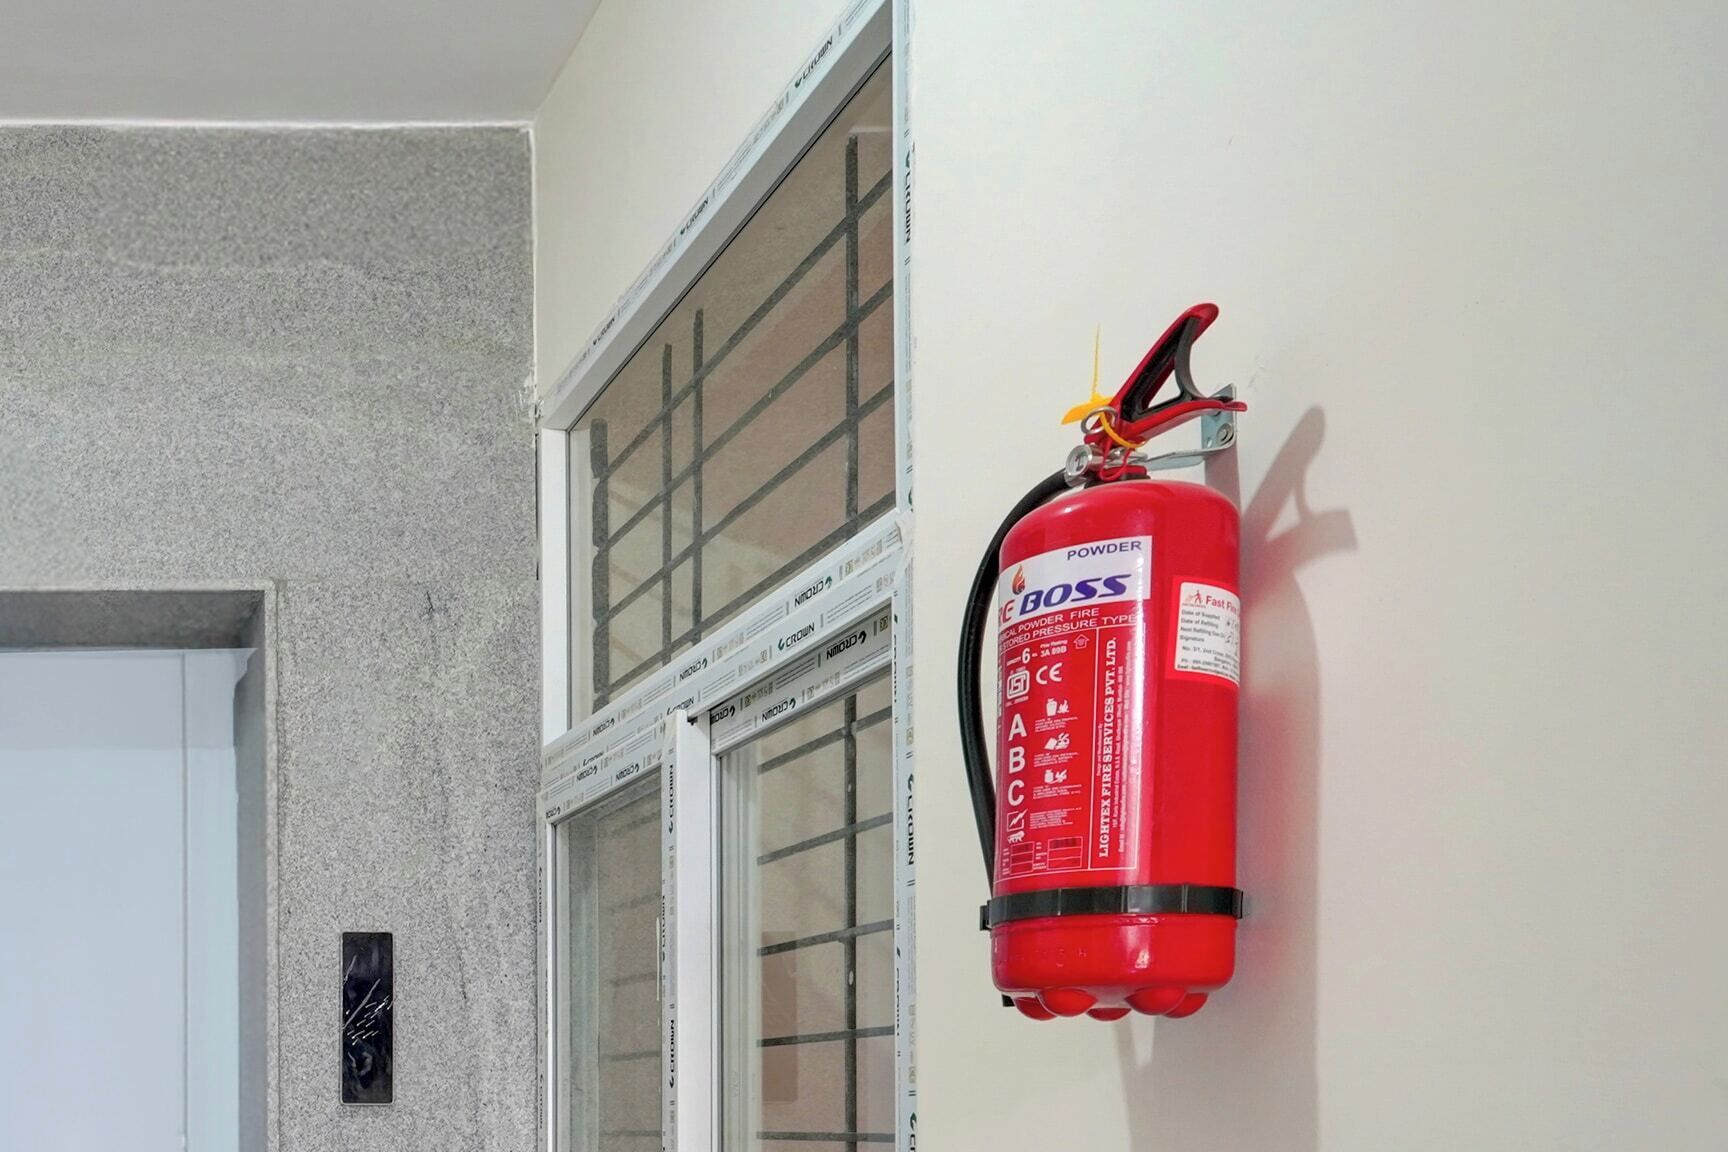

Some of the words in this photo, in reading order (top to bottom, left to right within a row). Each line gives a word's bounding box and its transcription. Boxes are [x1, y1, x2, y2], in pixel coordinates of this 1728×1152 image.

[803, 36, 833, 79] CROWN
[1067, 540, 1143, 561] POWDER
[794, 580, 824, 607] CROWN
[1019, 573, 1132, 616] BOSS
[1206, 595, 1225, 608] Fast
[1018, 613, 1064, 633] POWDER
[1070, 607, 1100, 620] FIRE
[1032, 617, 1098, 638] PRESSURE
[1102, 613, 1140, 626] TYPE
[785, 622, 815, 648] CROWN
[826, 634, 858, 660] CROWN
[1106, 637, 1117, 666] LTD.
[679, 660, 702, 682] CROWN
[1105, 667, 1116, 695] PVT.
[761, 699, 789, 723] CROWN
[1008, 713, 1028, 741] A
[1103, 697, 1114, 763] SERVICES
[1008, 746, 1026, 775] B
[1008, 779, 1025, 807] C
[1102, 763, 1112, 797] FIRE
[906, 796, 915, 865] CROWN
[1099, 798, 1111, 858] LIGHTEX
